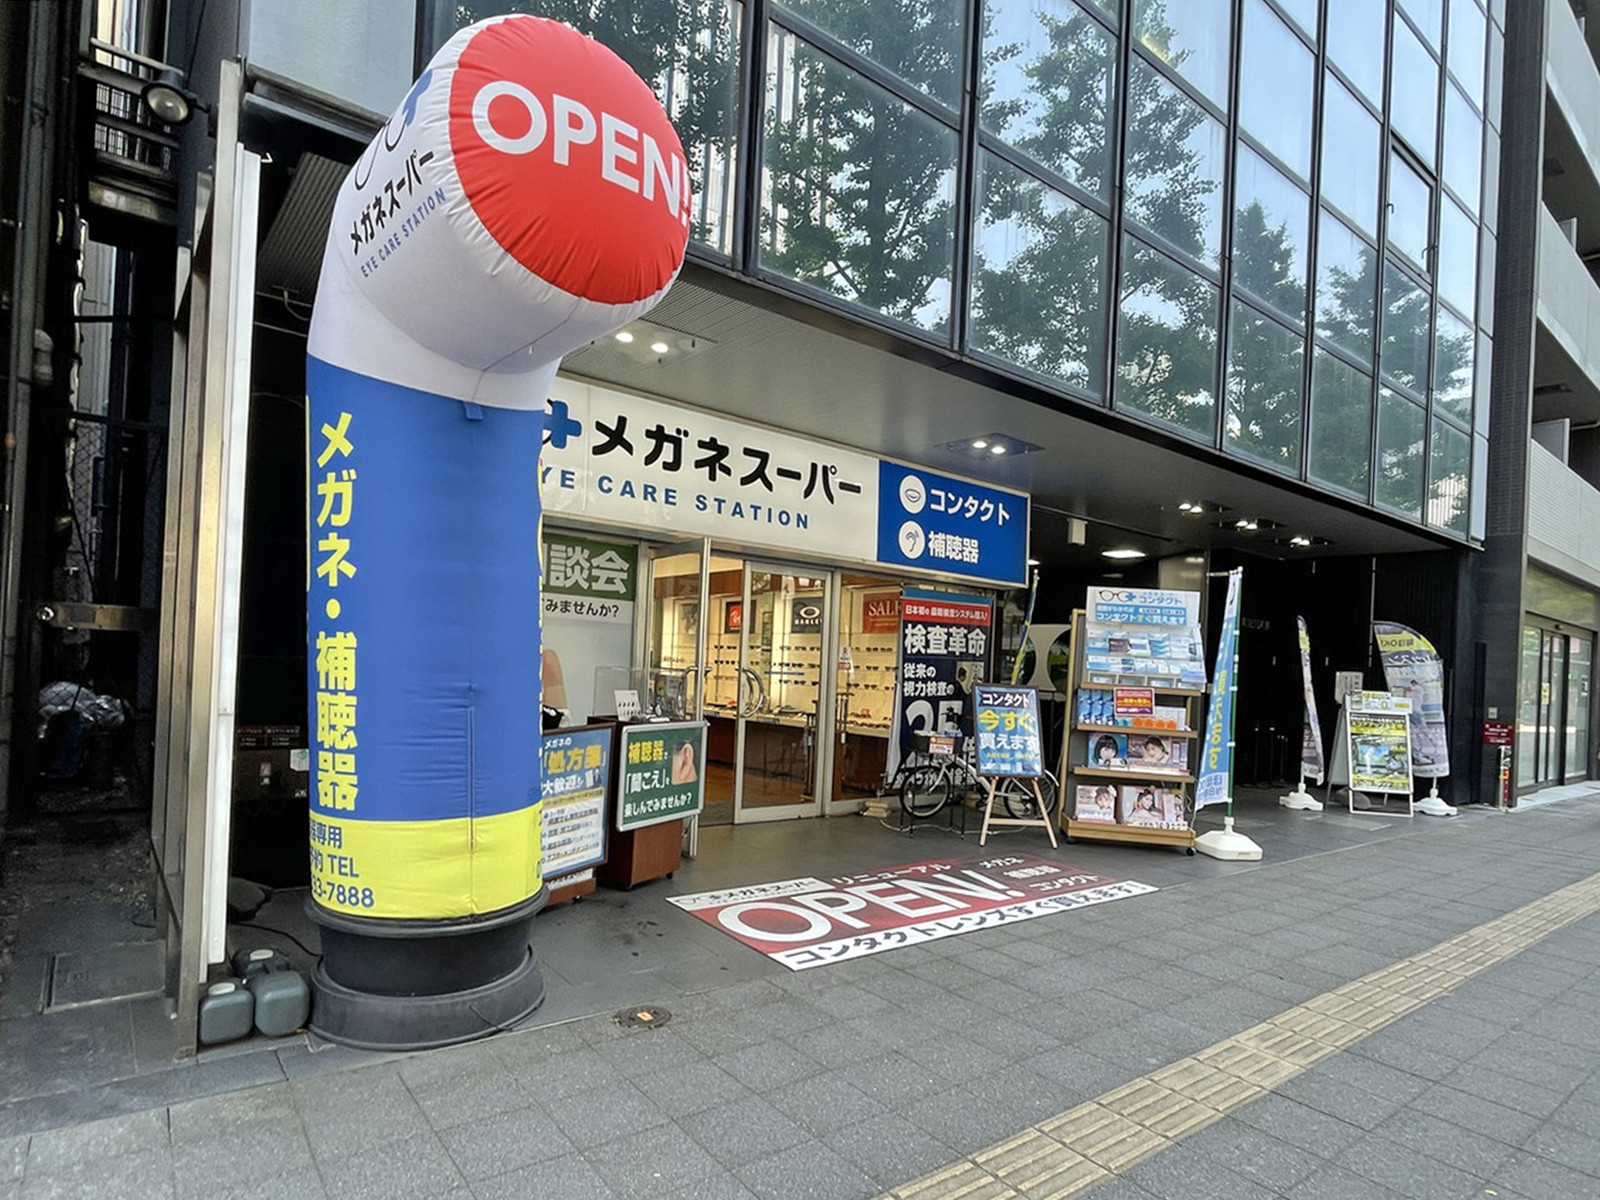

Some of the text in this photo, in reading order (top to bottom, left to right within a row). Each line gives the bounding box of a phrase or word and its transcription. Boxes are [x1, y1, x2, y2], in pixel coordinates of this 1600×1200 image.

[471, 80, 692, 228] OPEN!
[350, 149, 434, 255] メガネスーパー
[360, 187, 446, 278] EYE CARE STATION
[592, 415, 861, 505] メガネスーパー
[597, 475, 678, 506] CARE
[695, 494, 809, 529] STATION
[930, 488, 1011, 526] コンタクト
[928, 531, 980, 564] 補聴器
[542, 543, 630, 593] 談会
[316, 412, 358, 811] メガネ・補聴器
[542, 598, 619, 617] みませんか?
[794, 618, 822, 626] OAKLE
[904, 623, 987, 657] 検査革命
[904, 662, 937, 679] 従来の
[904, 680, 955, 697] 視力検査の
[982, 692, 1030, 708] コンタクト
[979, 709, 1036, 733] 今すぐ
[979, 732, 1038, 752] 買えます
[624, 792, 692, 817] 楽しんでみませんか?
[327, 853, 359, 878] TEL
[832, 863, 952, 885] リニューアル
[1028, 874, 1099, 891] コンタクト
[717, 869, 1027, 943] OPEN!
